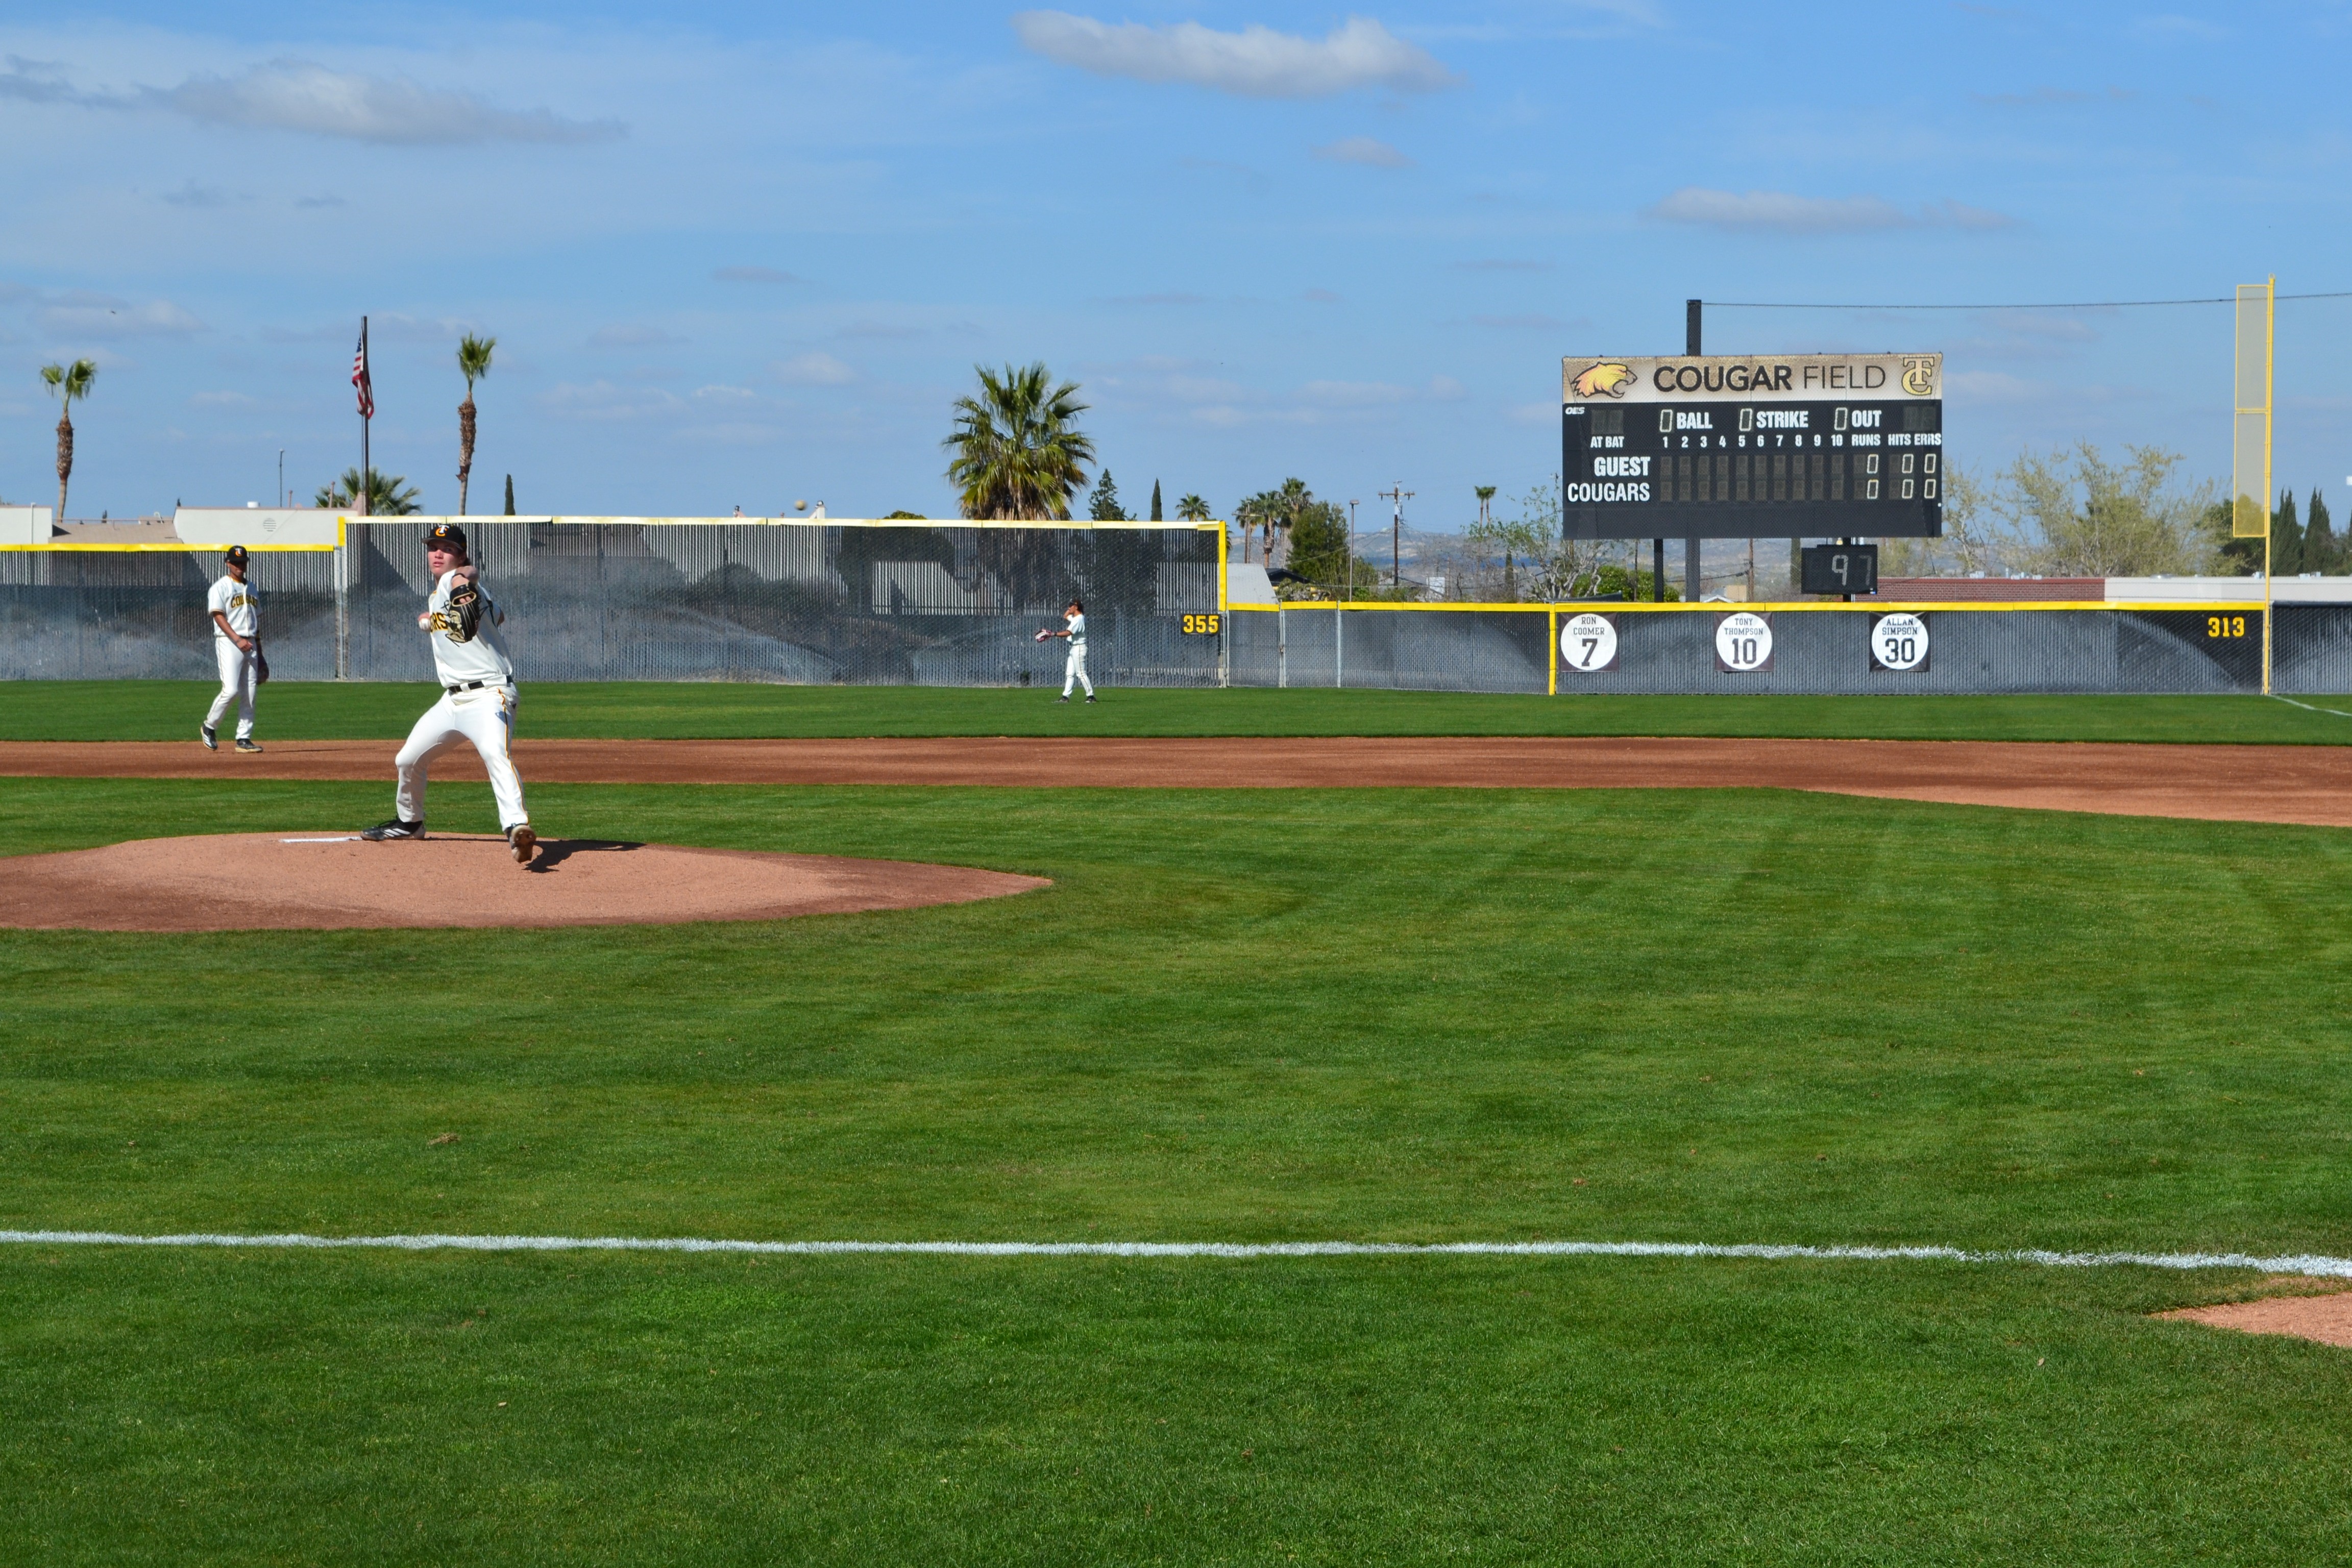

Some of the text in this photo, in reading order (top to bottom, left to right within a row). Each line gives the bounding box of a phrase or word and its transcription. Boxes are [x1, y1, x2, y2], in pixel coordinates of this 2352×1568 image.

[1653, 365, 1886, 392] COUGAR FIELD
[1659, 407, 1882, 432] 0 BALL 0 STRIKE 0 OUT
[1590, 433, 1942, 448] AT BAT 1 2 3 4 5 6 7 8 9 10 RUNS HITS ERRS
[1594, 453, 1937, 476] GUEST 0 0 0
[1567, 479, 1936, 502] COUGARS 0 0 0
[1831, 555, 1872, 586] 97
[1183, 615, 1219, 633] 355
[2208, 617, 2244, 637] 313
[1581, 638, 1598, 667] 7
[1732, 638, 1757, 664] 10
[1885, 638, 1915, 663] 30
